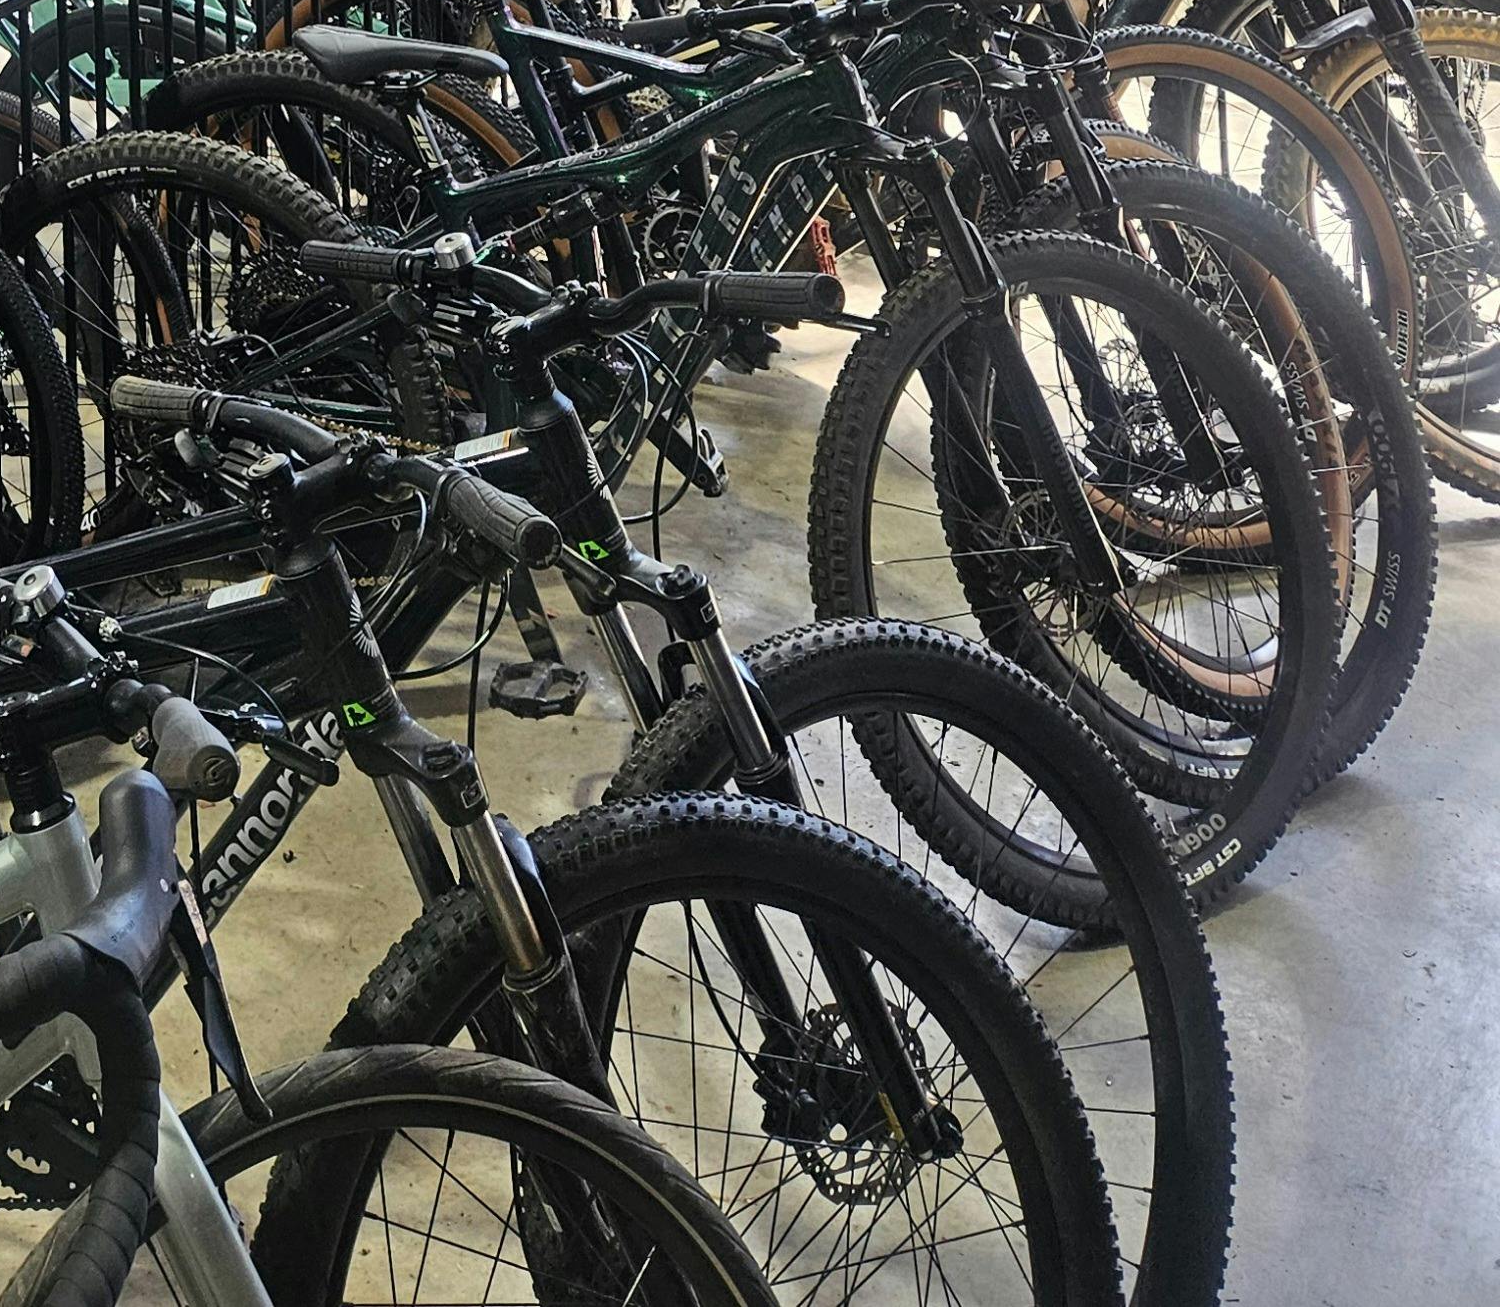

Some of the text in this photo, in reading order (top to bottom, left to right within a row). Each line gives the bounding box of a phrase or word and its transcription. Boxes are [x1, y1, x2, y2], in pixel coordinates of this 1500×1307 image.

[1285, 361, 1311, 411] SWISS
[1374, 550, 1401, 629] DT SWISS
[1215, 837, 1242, 869] CST
